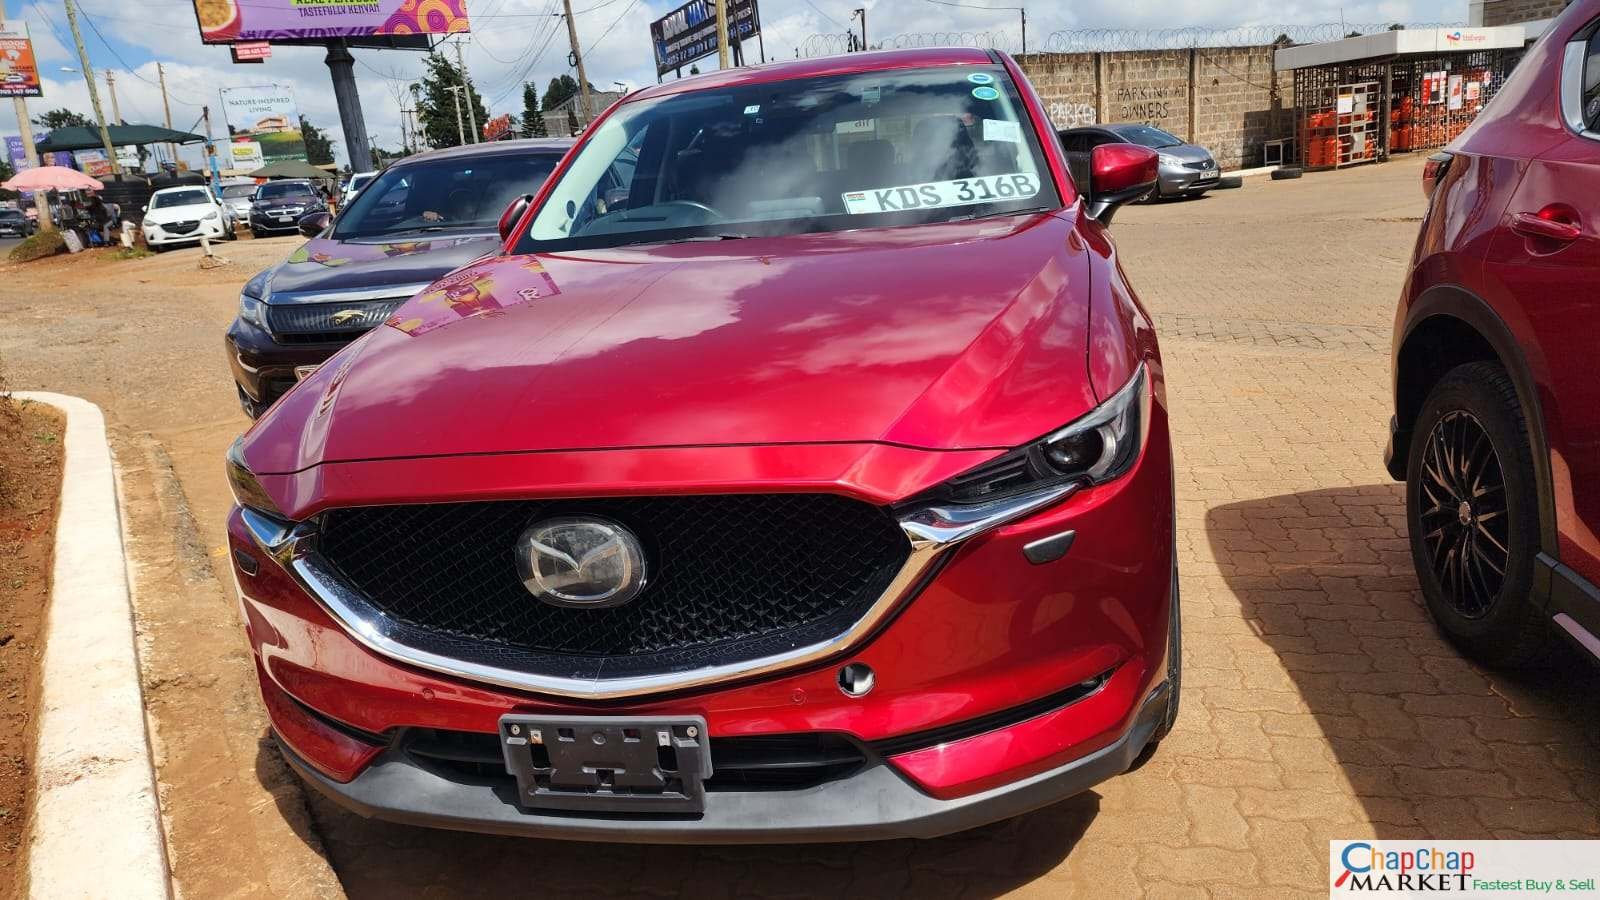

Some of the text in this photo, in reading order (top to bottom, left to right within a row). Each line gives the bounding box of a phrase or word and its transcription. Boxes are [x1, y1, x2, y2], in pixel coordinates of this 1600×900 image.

[297, 3, 381, 17] TASTEFULLY KENYAN
[1117, 85, 1168, 102] PARKING
[249, 105, 272, 113] LIVING
[1121, 101, 1169, 119] OWNERS
[874, 175, 1037, 211] KDS 316B
